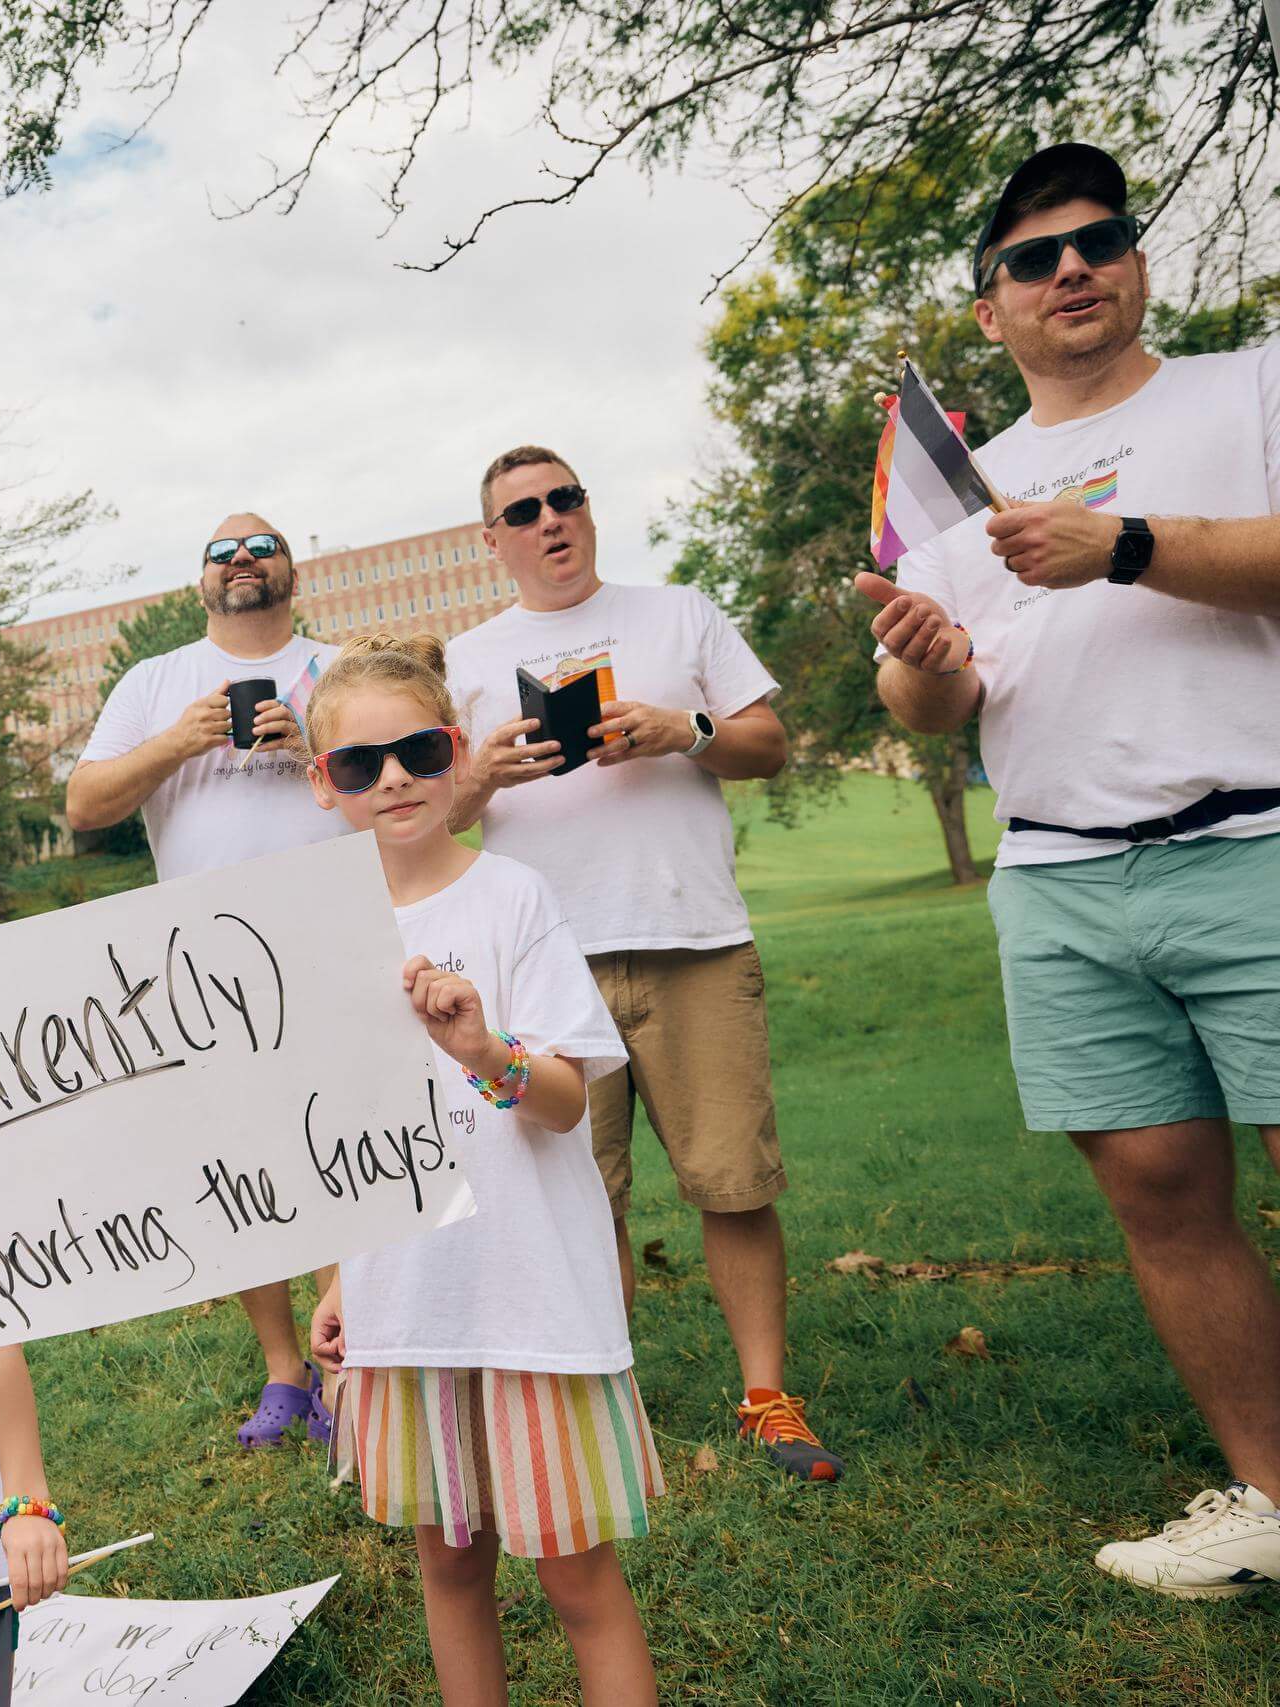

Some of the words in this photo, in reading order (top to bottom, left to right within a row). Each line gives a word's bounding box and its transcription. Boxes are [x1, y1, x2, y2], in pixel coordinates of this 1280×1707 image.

[1051, 464, 1090, 490] never
[1091, 444, 1135, 470] made
[554, 645, 586, 658] never
[588, 635, 619, 650] made
[255, 759, 275, 771] less
[277, 760, 297, 776] gay
[195, 1158, 297, 1234] the
[305, 1078, 456, 1213] Gays!
[21, 1604, 86, 1648] an
[116, 1623, 173, 1650] we
[83, 1655, 194, 1707] dog?
